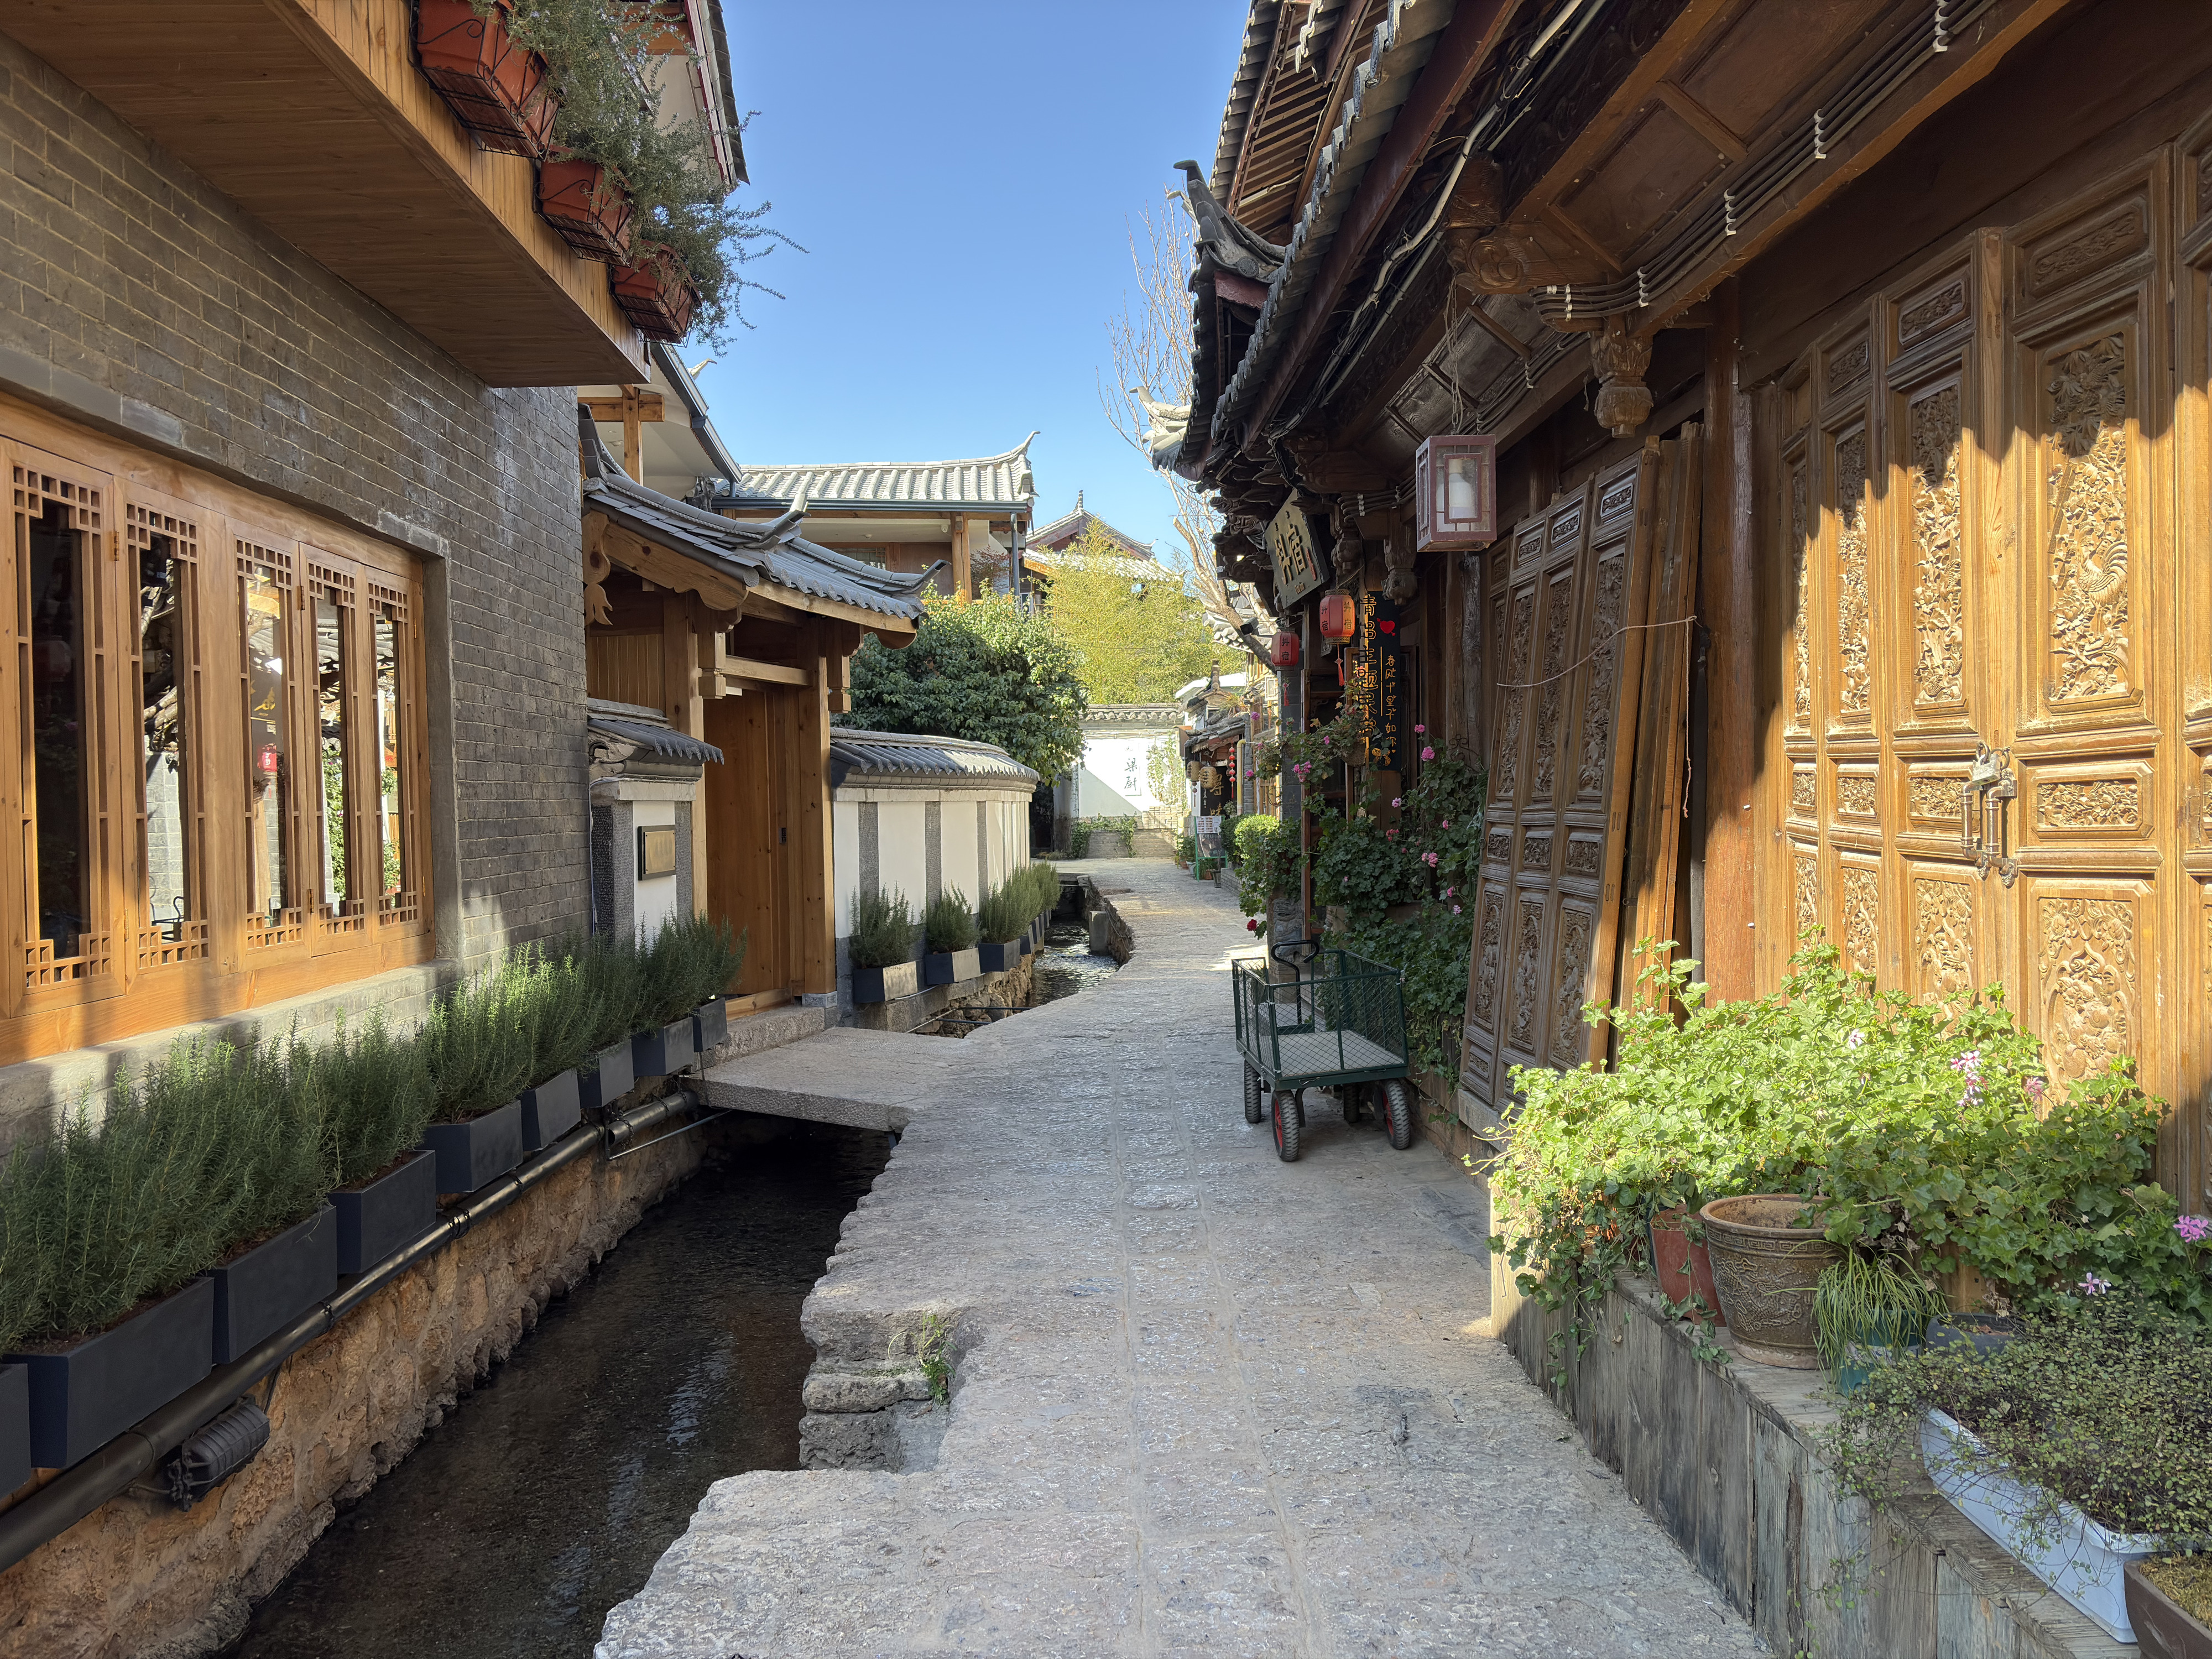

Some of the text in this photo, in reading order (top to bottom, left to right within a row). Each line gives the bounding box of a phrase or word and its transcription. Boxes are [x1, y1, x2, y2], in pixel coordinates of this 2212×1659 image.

[1274, 524, 1306, 585] 抖宿
[1344, 601, 1352, 630] 抖宿
[1281, 637, 1290, 661] 抖宿
[1385, 654, 1396, 747] 春风十里不如你
